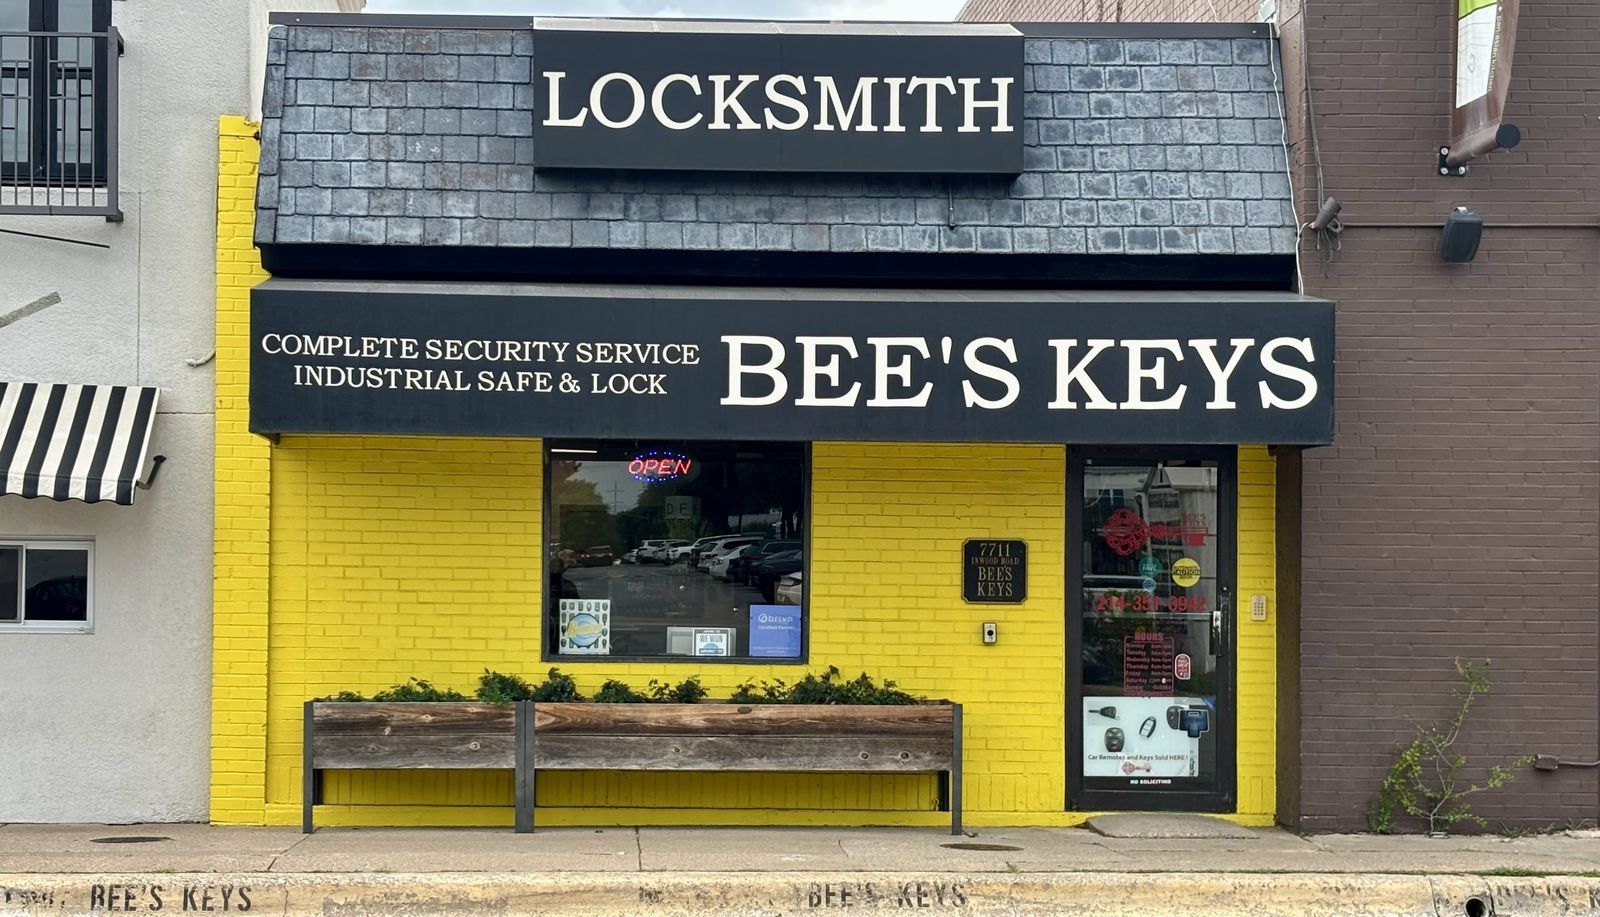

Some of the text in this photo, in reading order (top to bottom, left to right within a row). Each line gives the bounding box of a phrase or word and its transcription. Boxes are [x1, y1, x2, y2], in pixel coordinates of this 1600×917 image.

[542, 71, 1015, 132] LOCKSMITH
[261, 333, 700, 365] COMPLETE SECURITY SERVICE
[294, 365, 668, 395] INDUSTRIAL SAFE & LOCK
[720, 335, 1319, 411] BEE'S KEYS
[628, 458, 692, 476] OPEN
[980, 543, 1010, 557] 7711
[971, 557, 1020, 565] INWOOD ROAD
[978, 565, 1012, 581] BEE'S
[977, 582, 1013, 597] KEYS
[700, 635, 709, 643] WE
[1135, 632, 1164, 641] HOURS
[91, 884, 163, 911] BEE'S
[183, 884, 252, 912] KEYS
[898, 881, 966, 908] KEYS
